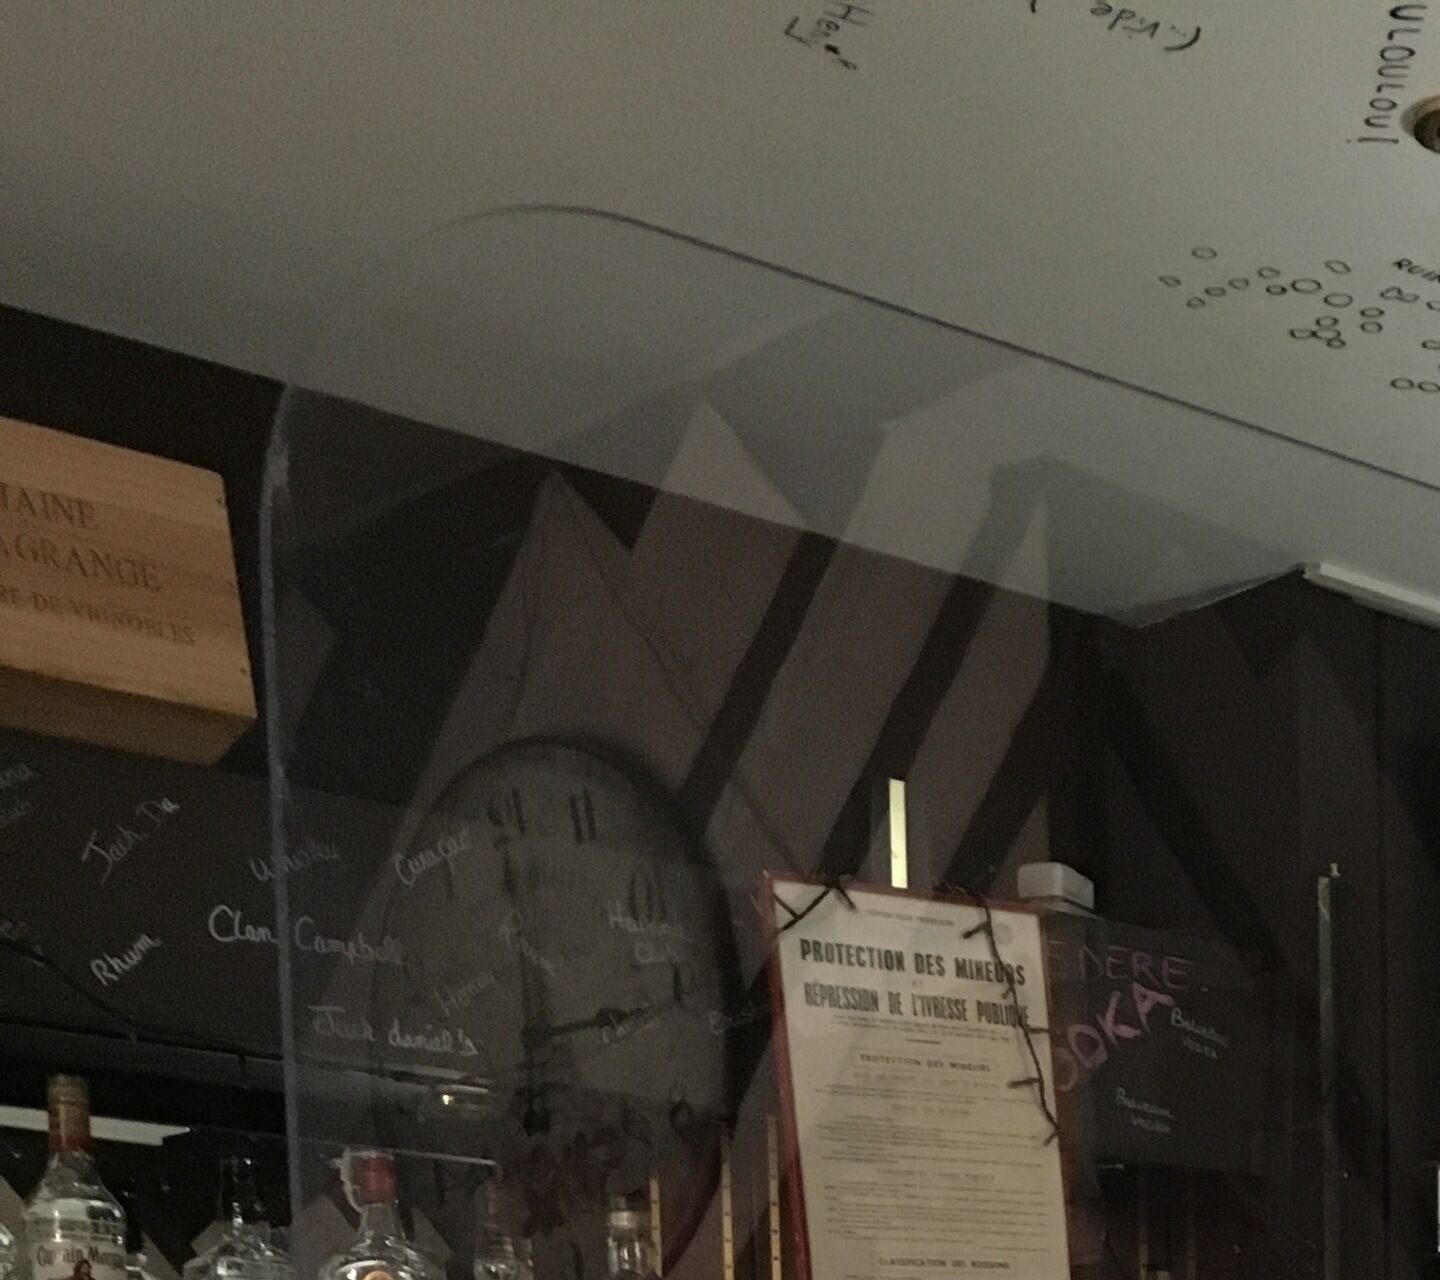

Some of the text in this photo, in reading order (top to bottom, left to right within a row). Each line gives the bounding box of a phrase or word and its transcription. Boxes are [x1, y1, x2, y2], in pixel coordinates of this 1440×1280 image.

[89, 932, 163, 987] Rhum
[800, 938, 1026, 987] PROTECTION DES MINEURS
[803, 978, 880, 1014] RÉPRESSION
[887, 990, 905, 1018] DE
[911, 992, 969, 1023] L'IVRESSE
[975, 1000, 1031, 1030] PUBLIQUE
